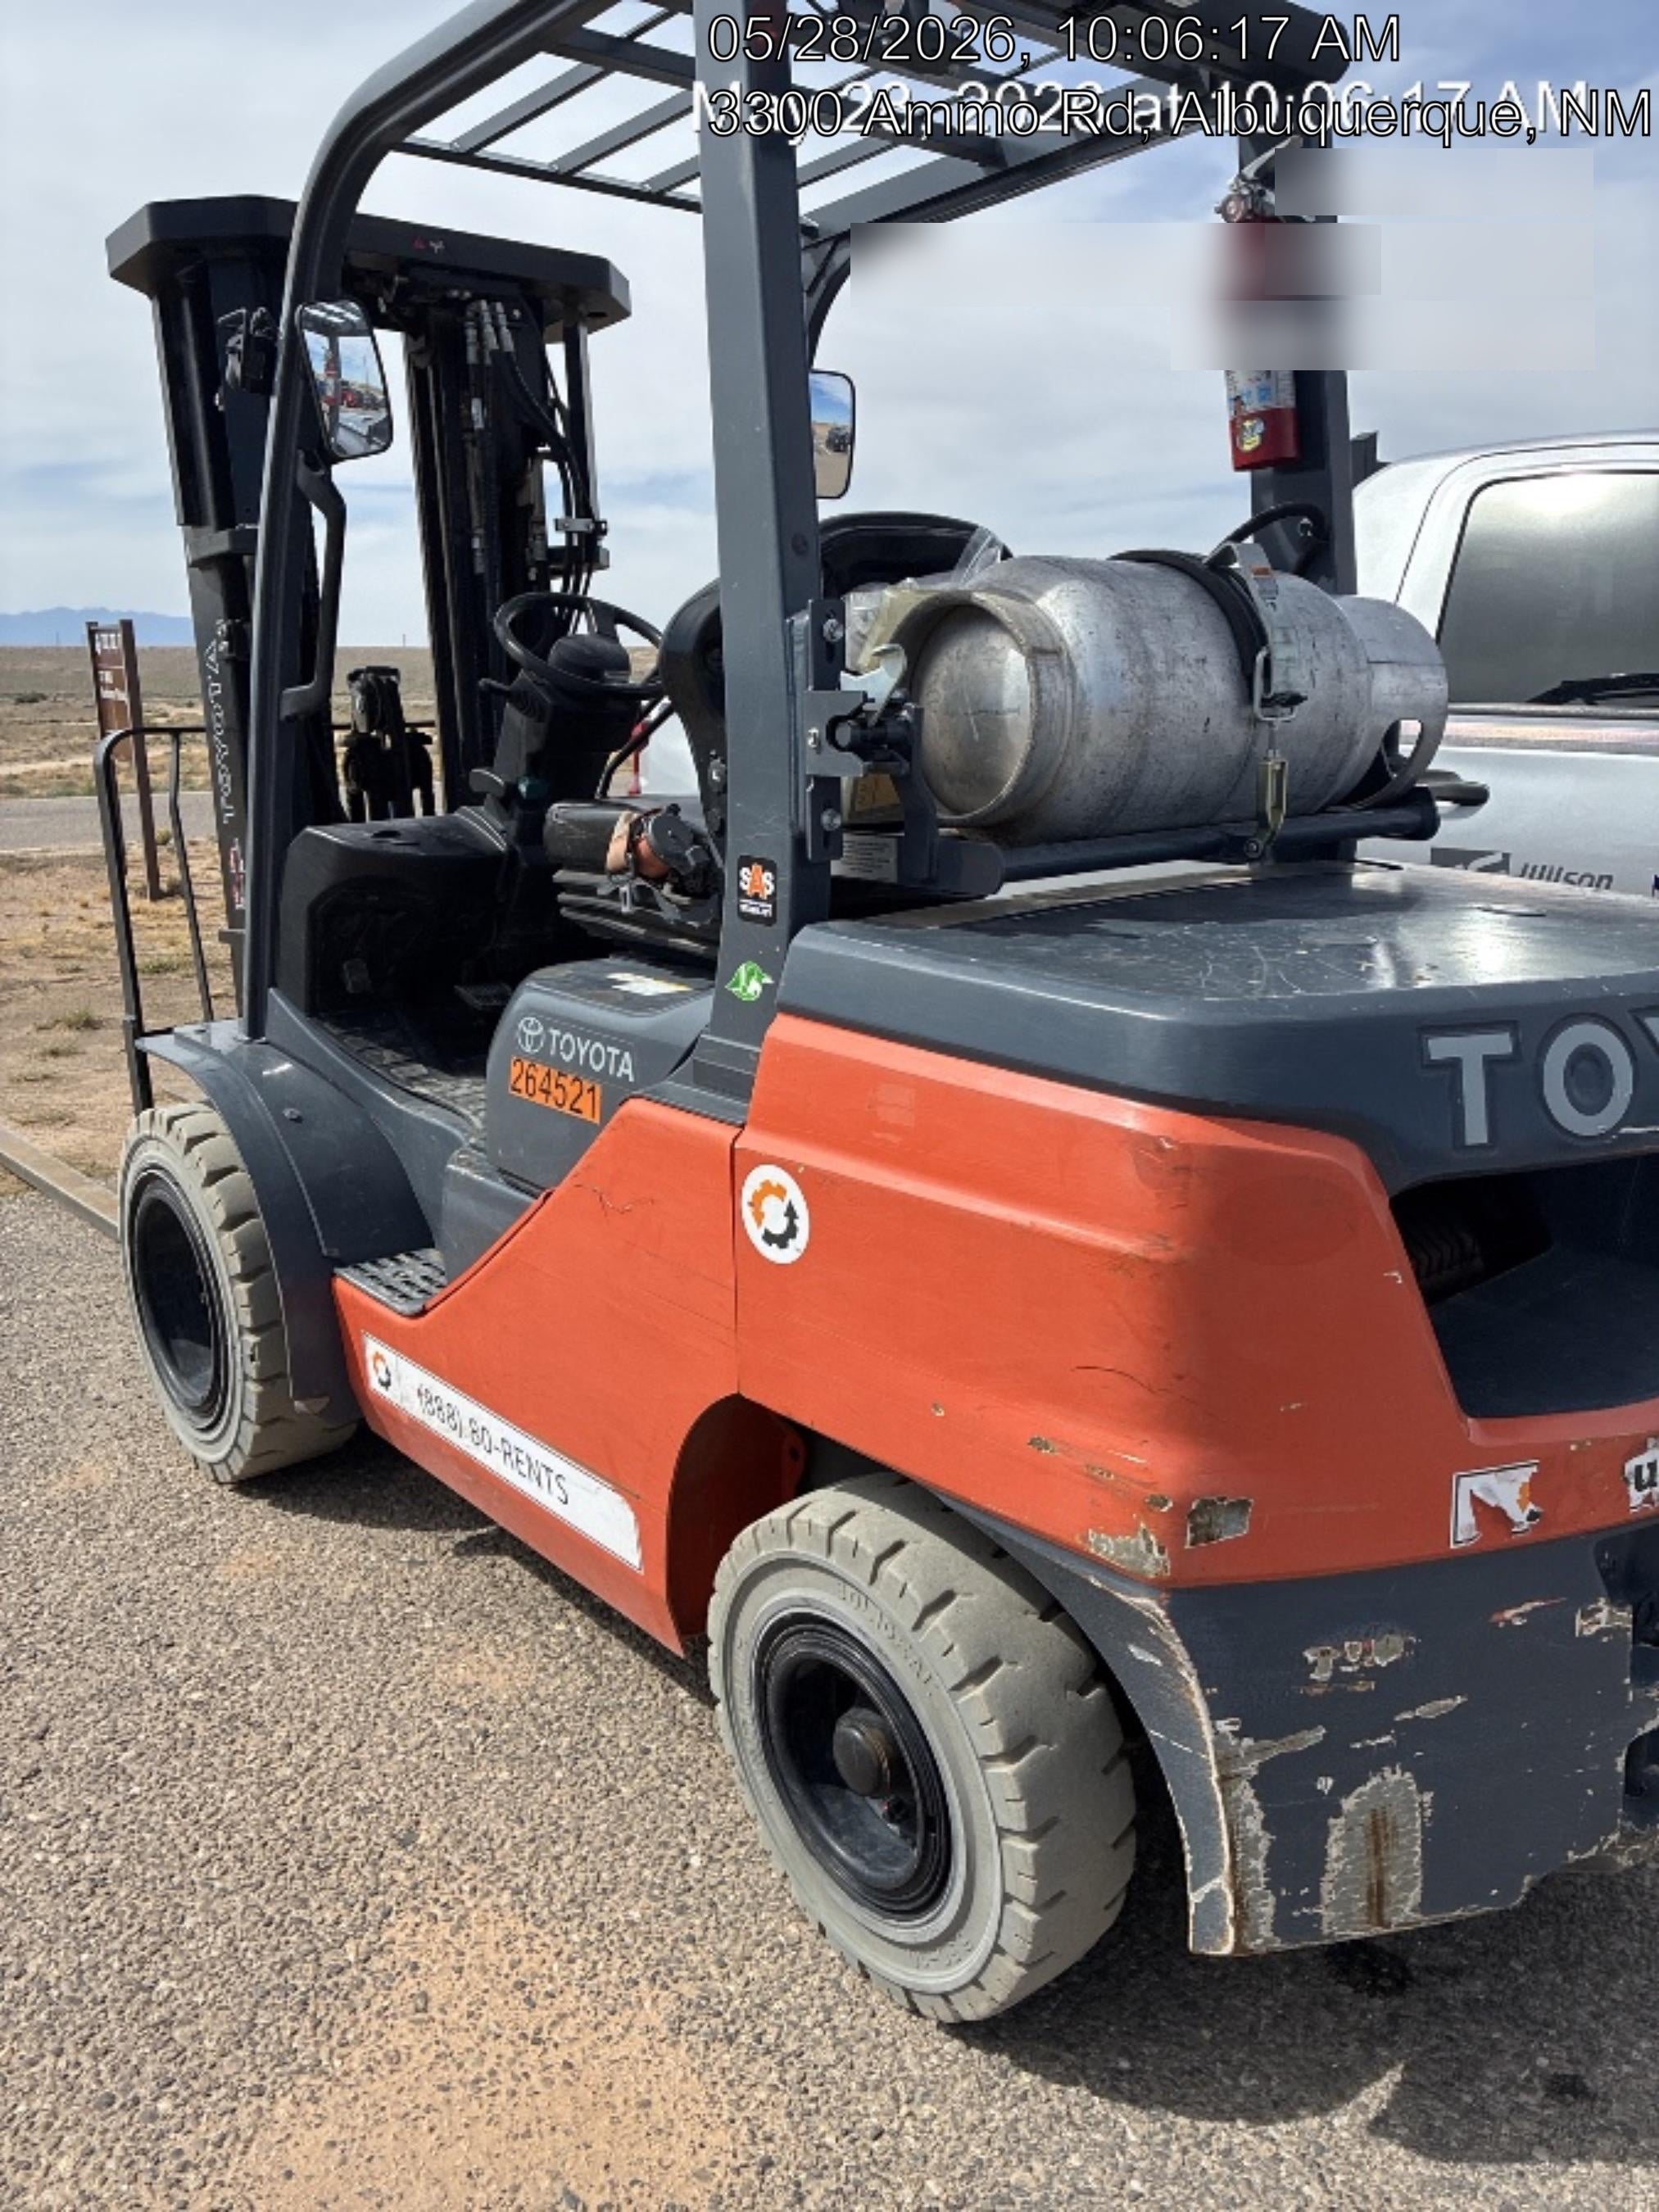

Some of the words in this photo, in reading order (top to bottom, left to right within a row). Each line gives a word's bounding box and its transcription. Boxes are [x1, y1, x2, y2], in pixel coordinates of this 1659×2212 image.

[510, 1058, 596, 1119] 264521
[547, 1027, 636, 1082] TOYOTA
[1426, 1015, 1659, 1146] TO
[469, 1417, 569, 1506] 80-RENTS
